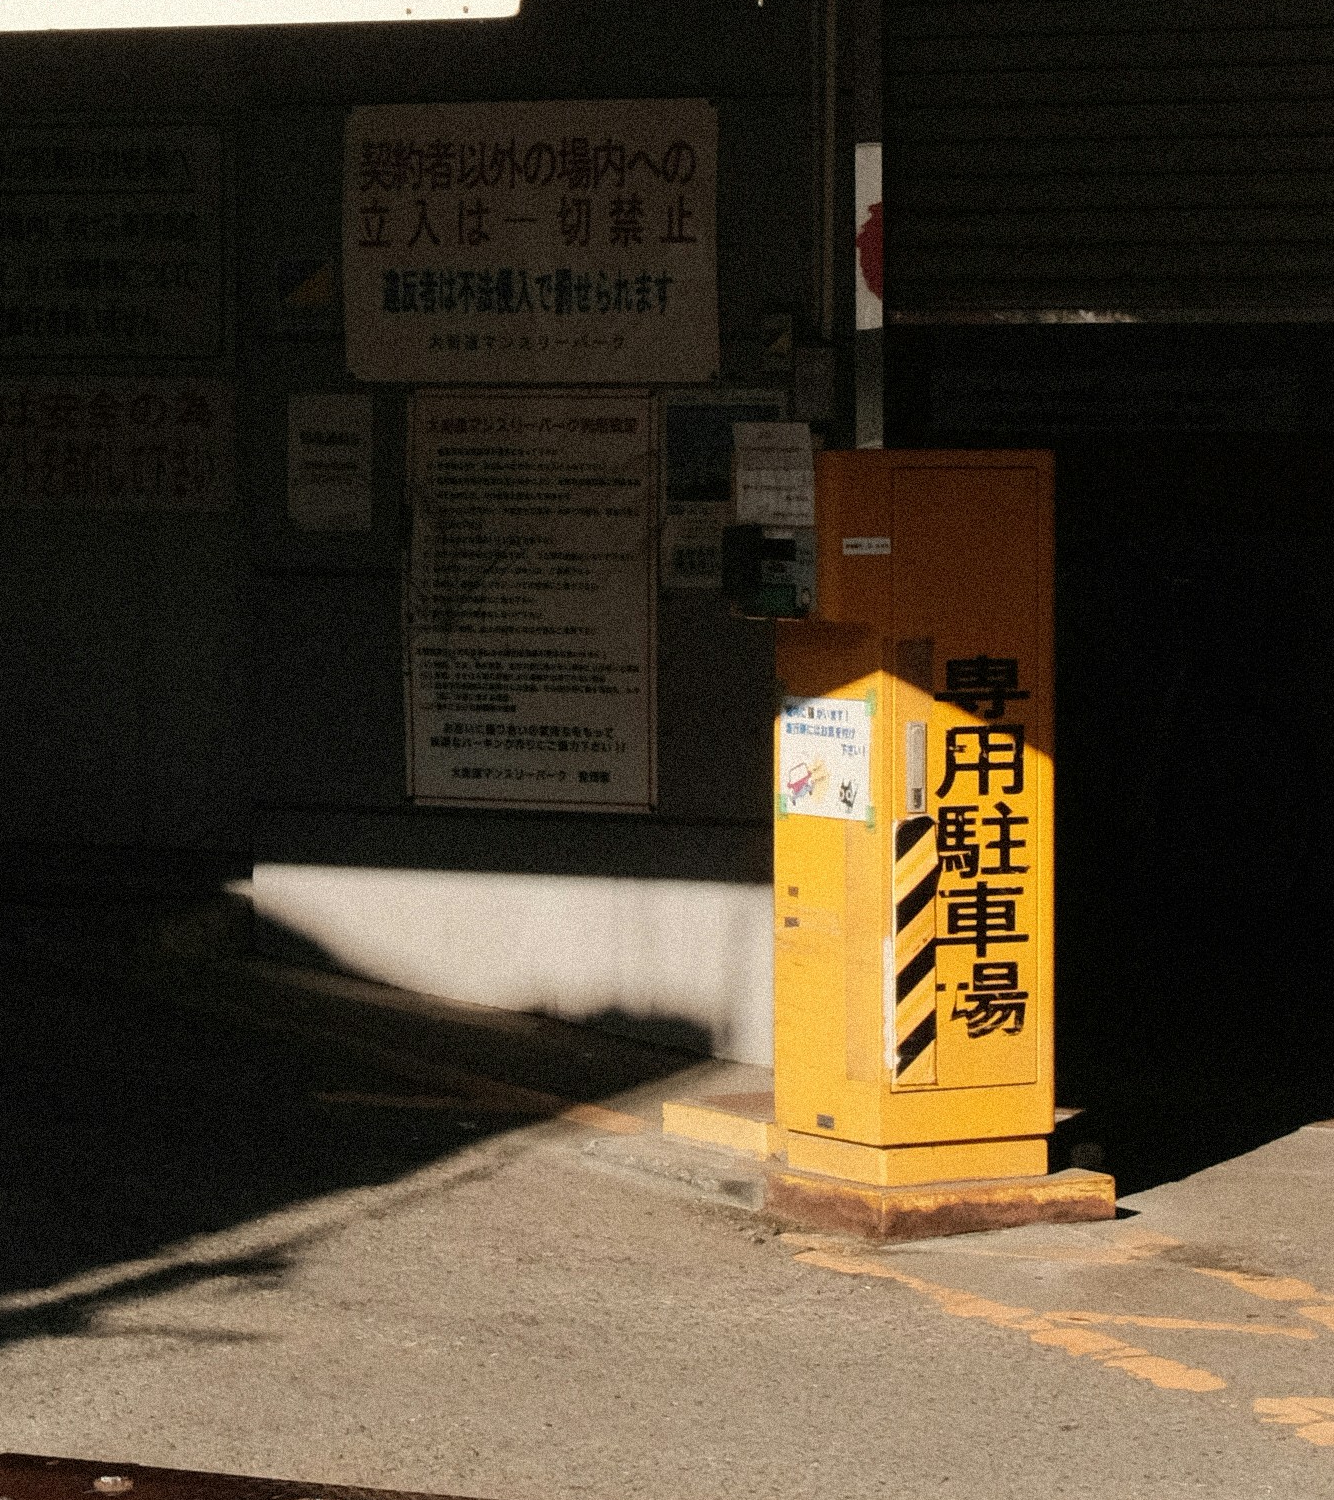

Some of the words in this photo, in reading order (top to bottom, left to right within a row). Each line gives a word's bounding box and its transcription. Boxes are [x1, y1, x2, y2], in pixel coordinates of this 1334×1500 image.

[934, 654, 1030, 1038] 専用駐車場
